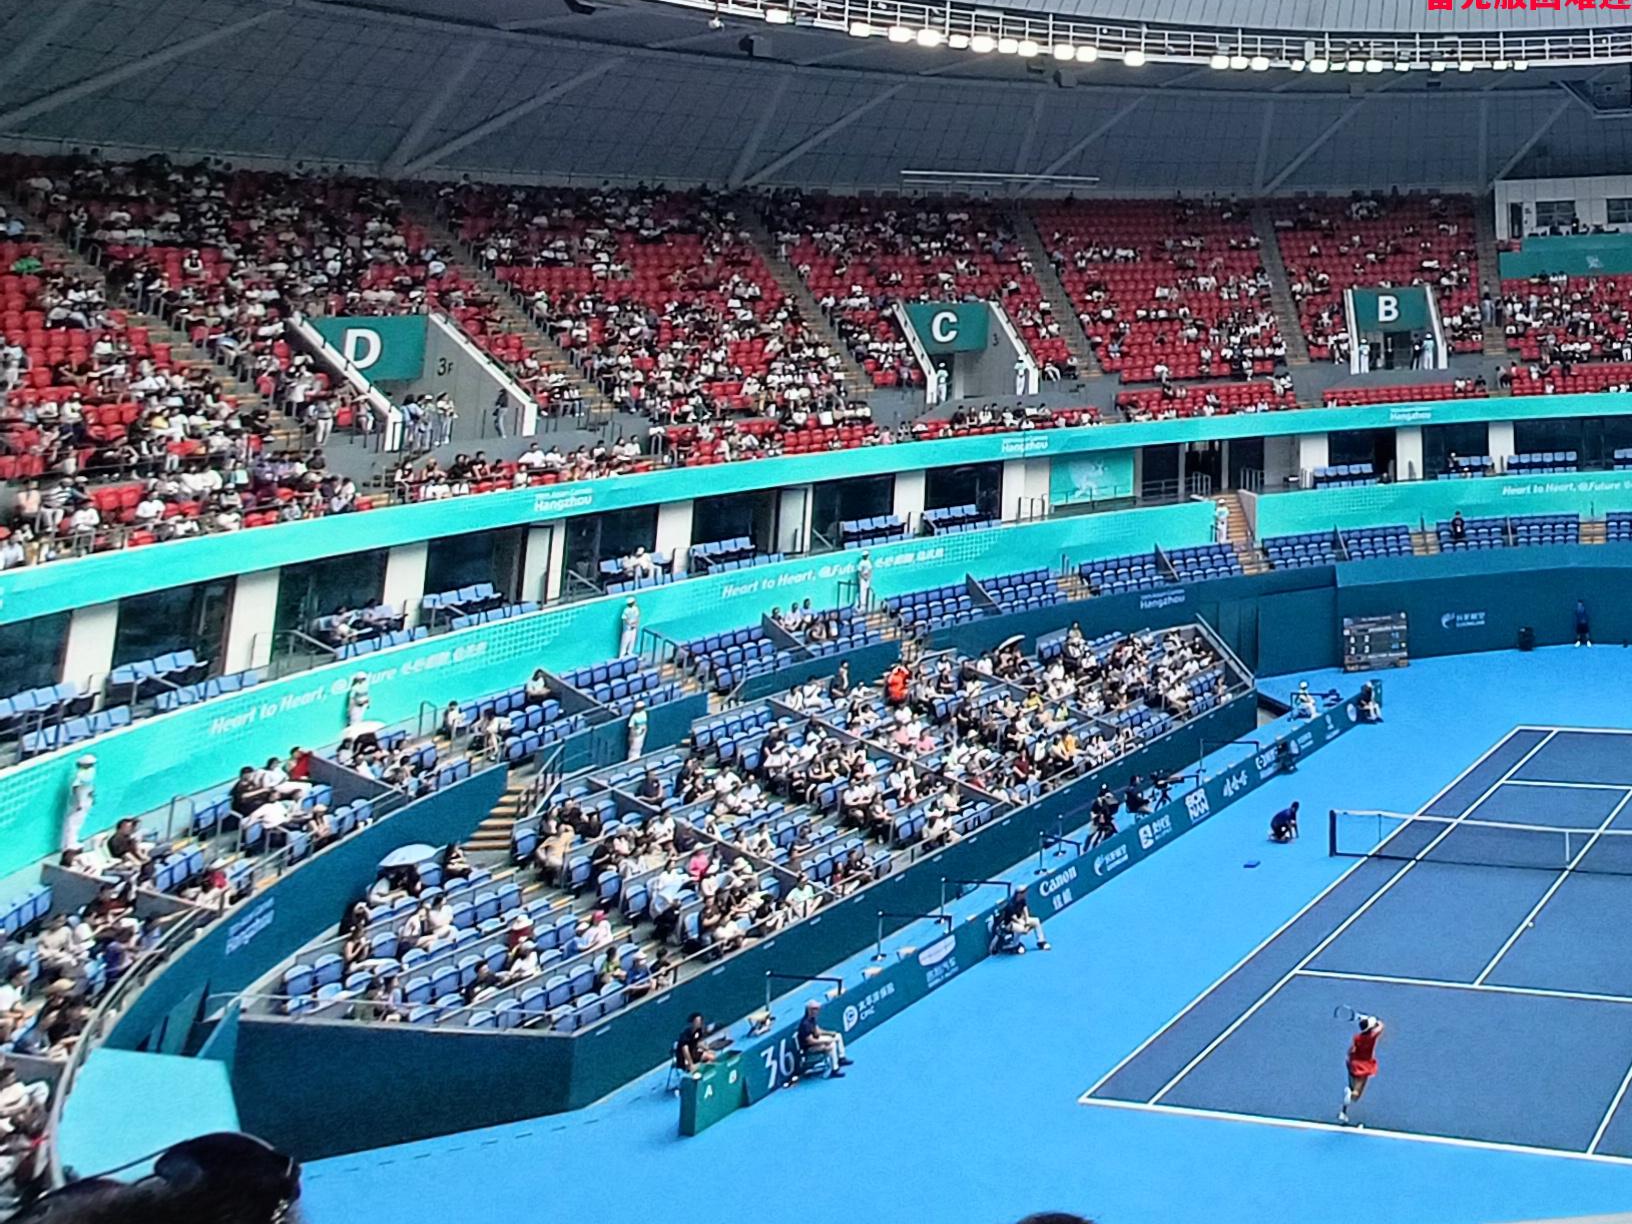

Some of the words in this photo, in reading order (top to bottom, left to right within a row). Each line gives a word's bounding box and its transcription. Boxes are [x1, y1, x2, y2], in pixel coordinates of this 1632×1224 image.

[1378, 295, 1399, 322] B
[932, 311, 958, 343] C
[344, 328, 382, 369] D
[722, 580, 758, 598] Heart
[762, 579, 775, 590] to
[1039, 865, 1078, 897] Canon
[704, 1084, 713, 1099] A
